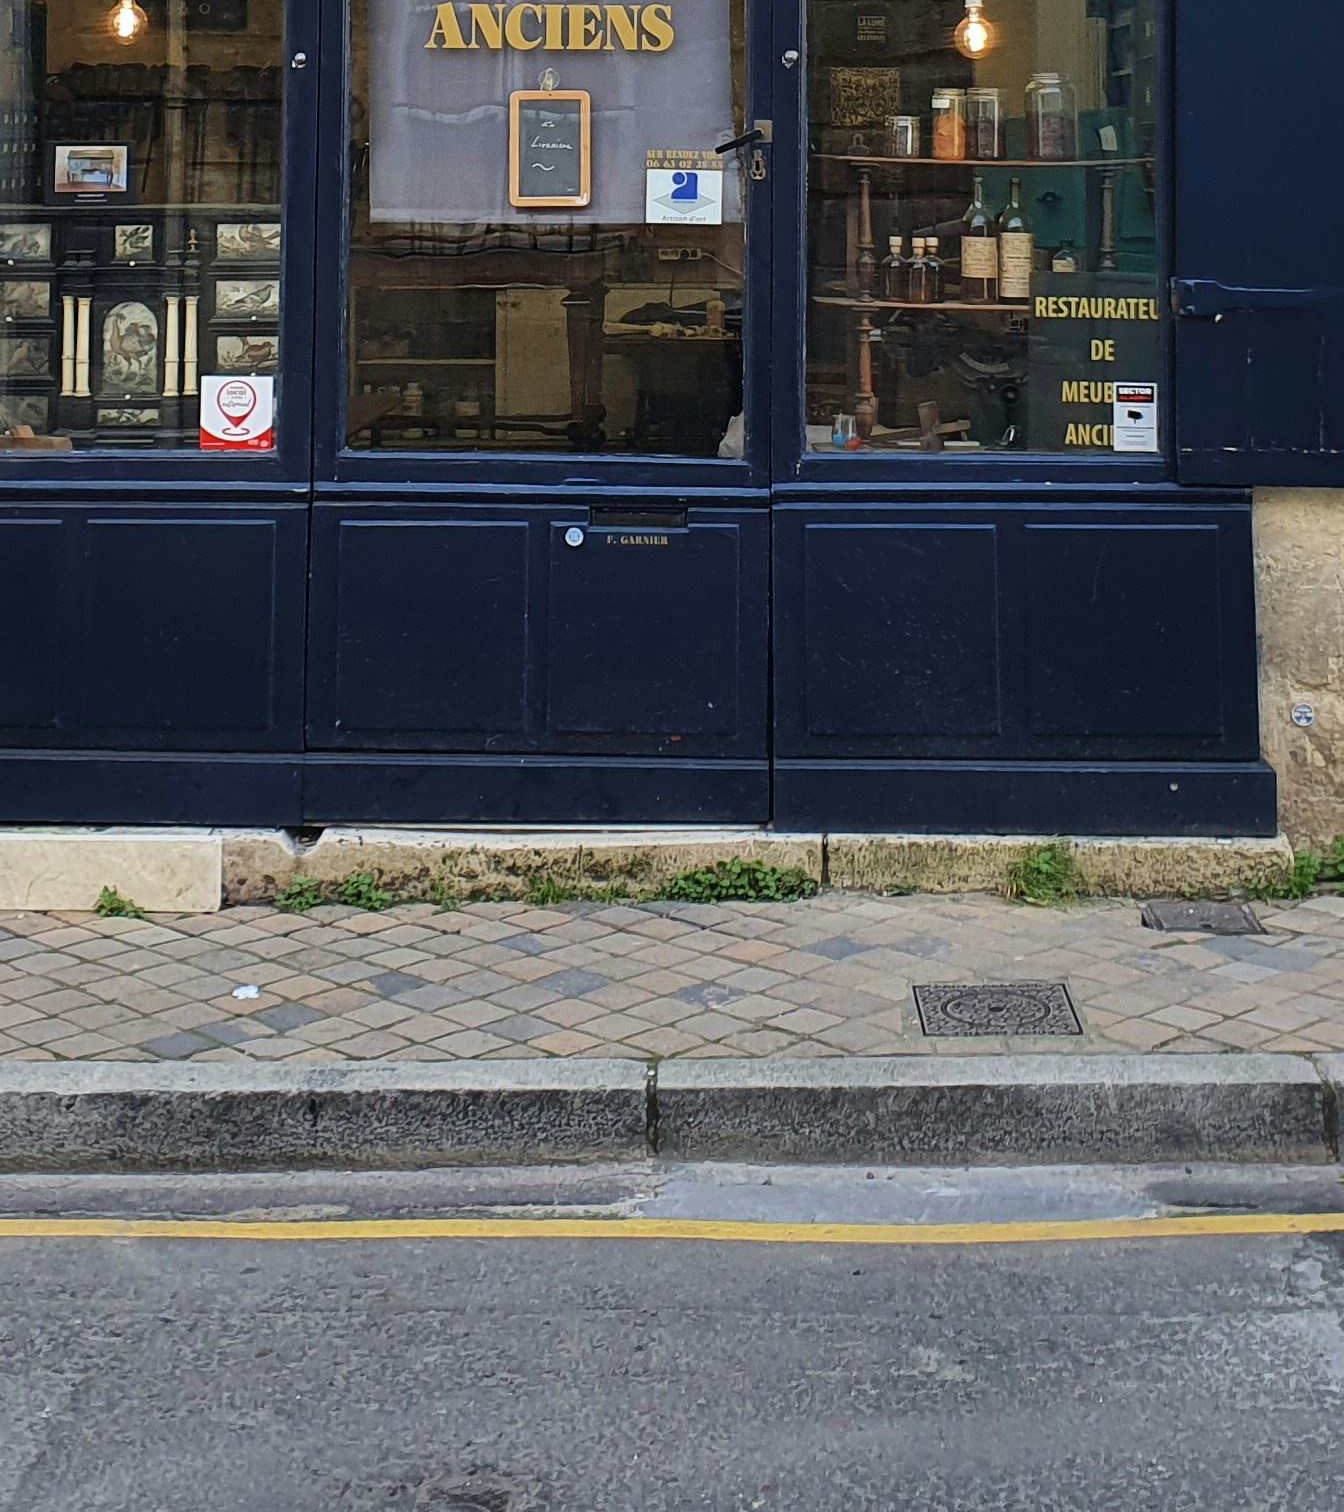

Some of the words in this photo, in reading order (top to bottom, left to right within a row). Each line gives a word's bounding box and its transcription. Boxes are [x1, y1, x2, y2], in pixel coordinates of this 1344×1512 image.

[424, 1, 675, 52] ANCIENS
[646, 159, 660, 168] 06
[1090, 339, 1115, 361] DE
[620, 535, 668, 545] GARNIER
